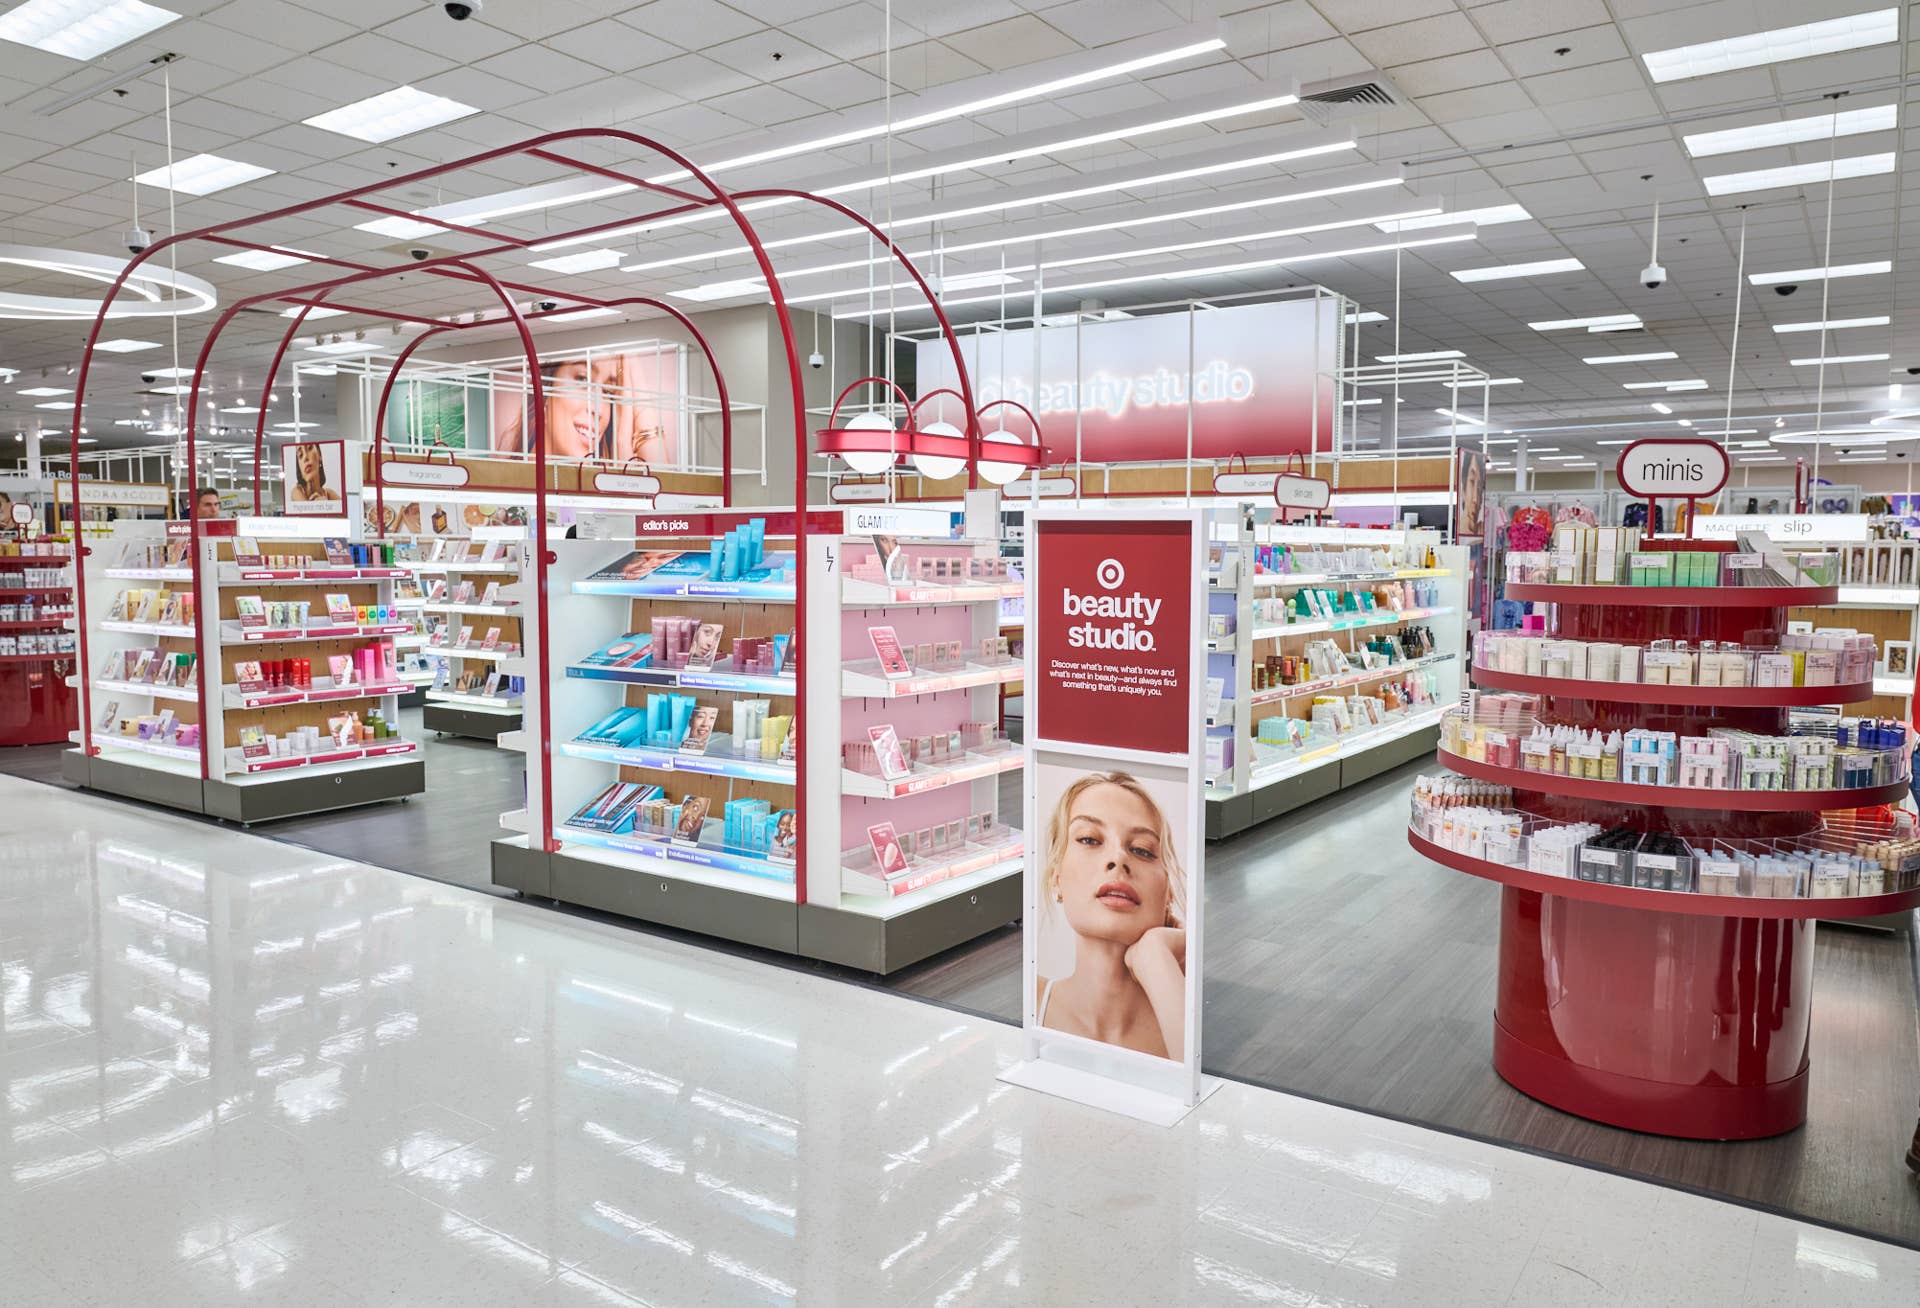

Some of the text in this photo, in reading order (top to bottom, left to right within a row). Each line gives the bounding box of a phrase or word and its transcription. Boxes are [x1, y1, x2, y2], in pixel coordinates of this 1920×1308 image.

[1010, 361, 1253, 418] beauty studio
[58, 470, 93, 480] Roms
[1643, 458, 1703, 481] minis
[65, 488, 117, 499] KNDRA
[643, 519, 689, 532] editor's picks
[1784, 519, 1813, 536] slip
[1063, 588, 1161, 625] beauty
[1068, 621, 1154, 652] studio
[1051, 659, 1175, 677] Discover what's new, what's now and
[1049, 670, 1070, 679] what's
[1071, 671, 1086, 679] next
[1087, 672, 1094, 680] in
[1138, 676, 1162, 686] always
[1163, 678, 1177, 687] find
[1062, 681, 1162, 697] something that's uniquely you.
